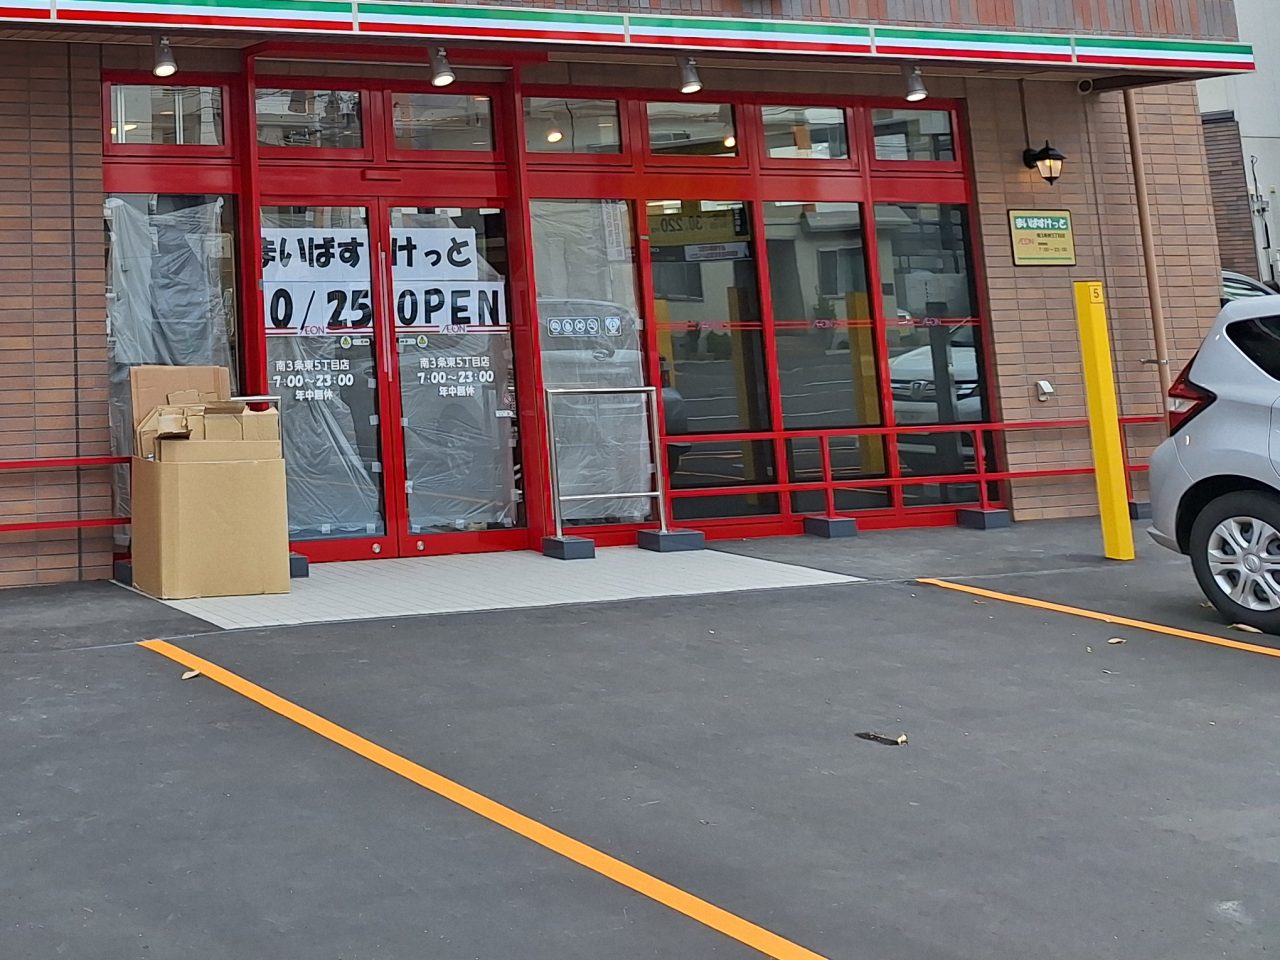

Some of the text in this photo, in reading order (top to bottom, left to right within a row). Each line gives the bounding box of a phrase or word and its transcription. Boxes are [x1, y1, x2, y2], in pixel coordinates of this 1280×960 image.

[1093, 287, 1100, 299] 5
[397, 288, 500, 326] OPEN
[275, 359, 350, 372] 南3条東5丁目店
[419, 356, 490, 369] 南3条東5丁目店
[295, 388, 334, 401] 年中無休
[439, 385, 476, 398] 年中無休
